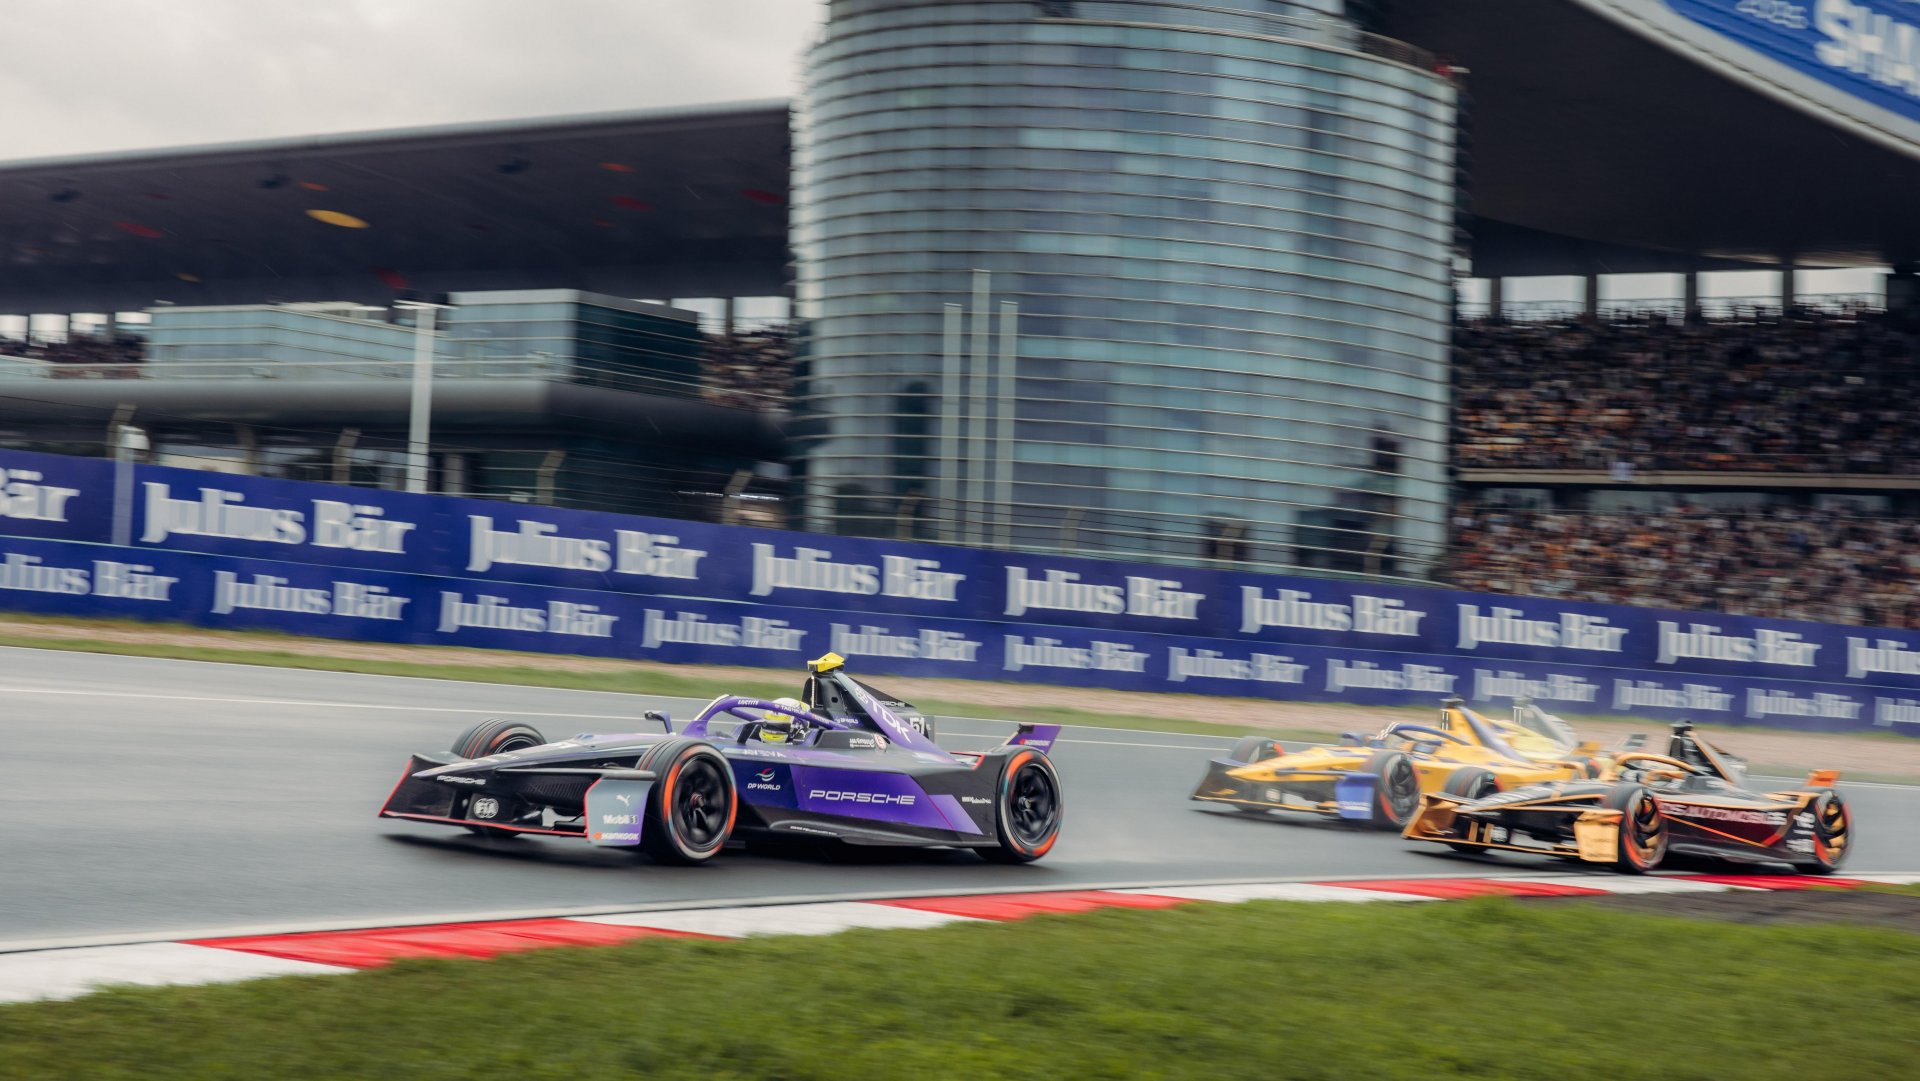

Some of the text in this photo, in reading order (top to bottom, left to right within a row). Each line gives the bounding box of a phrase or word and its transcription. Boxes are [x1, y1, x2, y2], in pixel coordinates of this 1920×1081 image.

[0, 468, 80, 522] är
[139, 482, 416, 554] Julius Bär
[466, 515, 708, 579] Julius Bär
[92, 560, 180, 601] Bär
[749, 543, 966, 601] Julius Bär
[210, 570, 411, 621] Julius Bär
[1004, 566, 1206, 620] Julius Bär
[1239, 586, 1427, 636] Julius Bär
[436, 591, 619, 637] Julius Bär
[640, 609, 808, 651] Julius Bär
[1456, 604, 1629, 652] Julius Bär
[829, 623, 983, 662] Julius Bär
[1003, 635, 1150, 672] Julius Bär
[1656, 621, 1822, 667] Julius Bär
[1167, 646, 1309, 684] Julius Bär
[1324, 658, 1458, 693] Julius Bär
[1473, 669, 1600, 702] Julius Bär
[1611, 679, 1735, 711] Julius Bär
[1746, 688, 1864, 719] Julius Bär
[867, 695, 912, 743] TDK
[909, 716, 925, 735] 51
[437, 775, 486, 785] PORSCHE
[757, 783, 781, 791] WORLD
[809, 789, 916, 805] PORSCHE
[603, 814, 630, 824] Mobil
